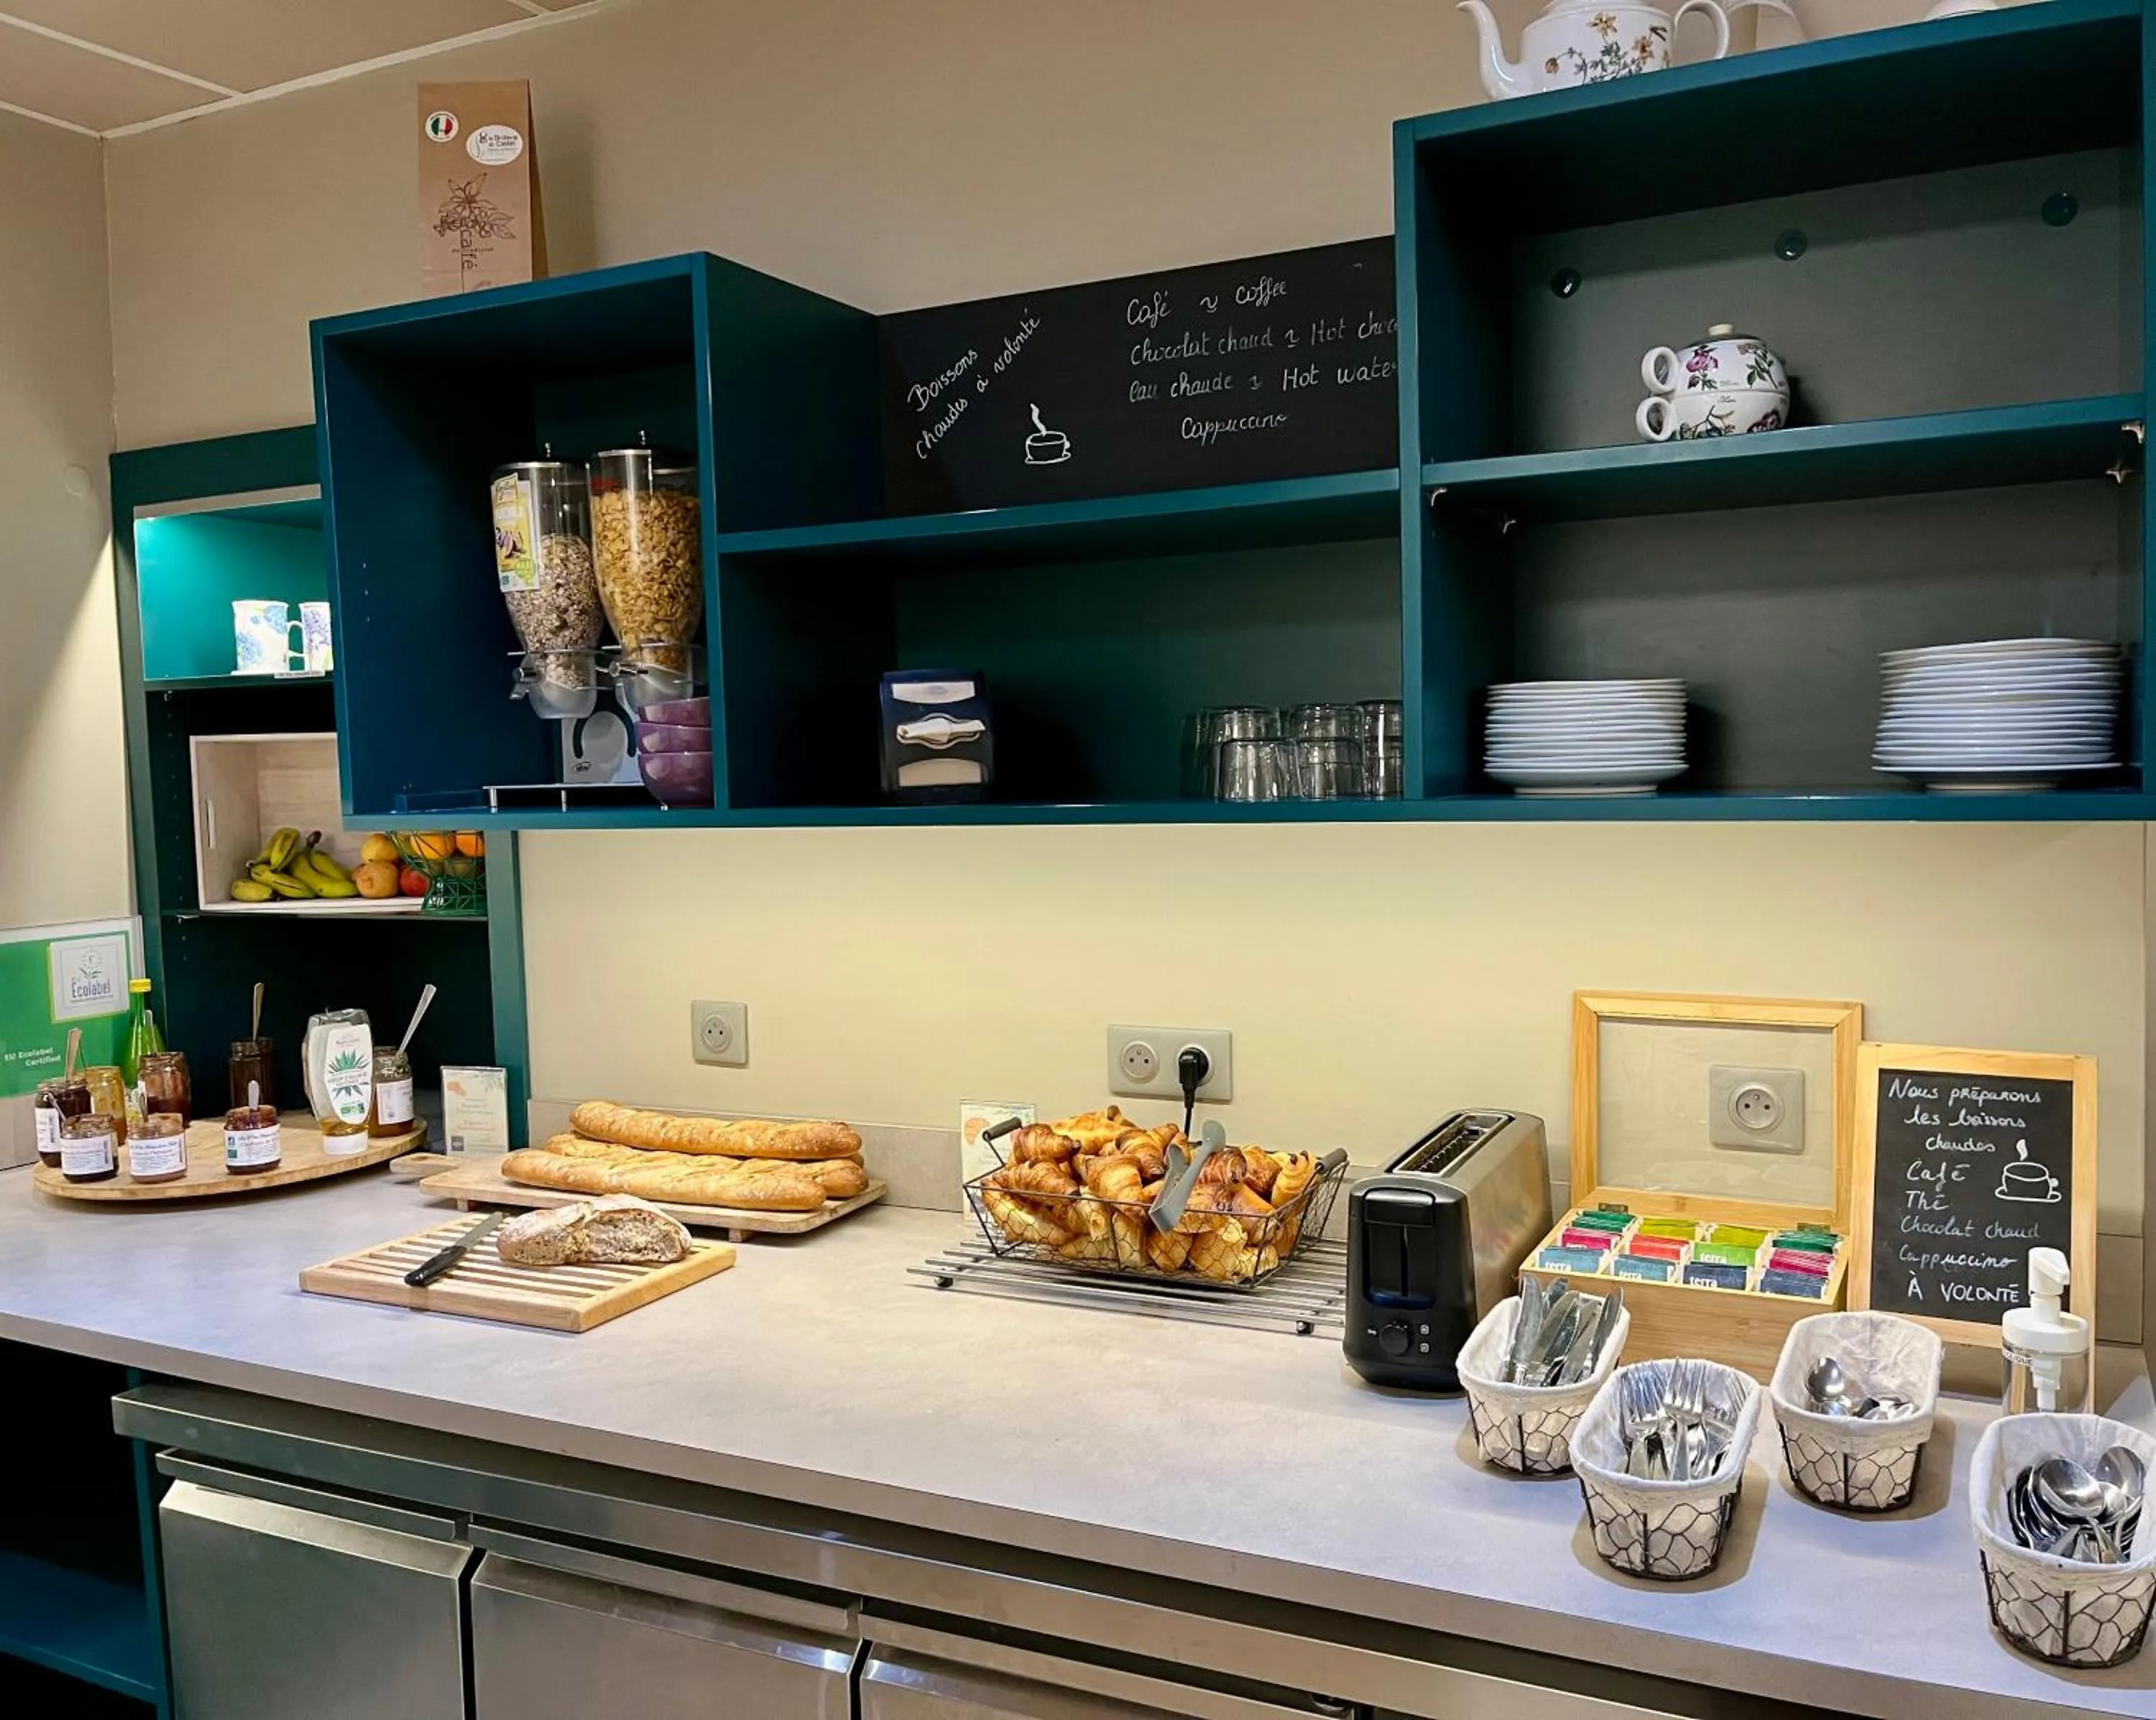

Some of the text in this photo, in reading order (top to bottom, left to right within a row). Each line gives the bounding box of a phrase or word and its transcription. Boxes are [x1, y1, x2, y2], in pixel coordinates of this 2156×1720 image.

[1127, 290, 1171, 328] Café
[1218, 326, 1273, 354] chaud
[1311, 318, 1345, 346] Hot
[977, 374, 989, 393] à
[994, 308, 1041, 374] volonté
[908, 349, 978, 412] Boissons
[1283, 363, 1319, 391] Hot
[1181, 413, 1290, 447] Cappuccino
[71, 977, 111, 998] Ecolabel
[4, 1047, 53, 1061] EU Ecolabel
[25, 1054, 61, 1066] Certified
[1888, 1078, 1939, 1099] Nous
[1904, 1104, 2027, 1128] les boissons
[1906, 1158, 1971, 1192] Café
[1906, 1190, 1949, 1211] Thé
[1901, 1215, 2041, 1239] Chocolat chaud
[1544, 1262, 1572, 1271] terra
[1699, 1253, 1727, 1264] terra
[1899, 1244, 2017, 1270] Cappuccino
[1619, 1270, 1642, 1280] terra
[1689, 1276, 1718, 1287] terra
[1908, 1270, 2020, 1303] À VOLONTÉ
